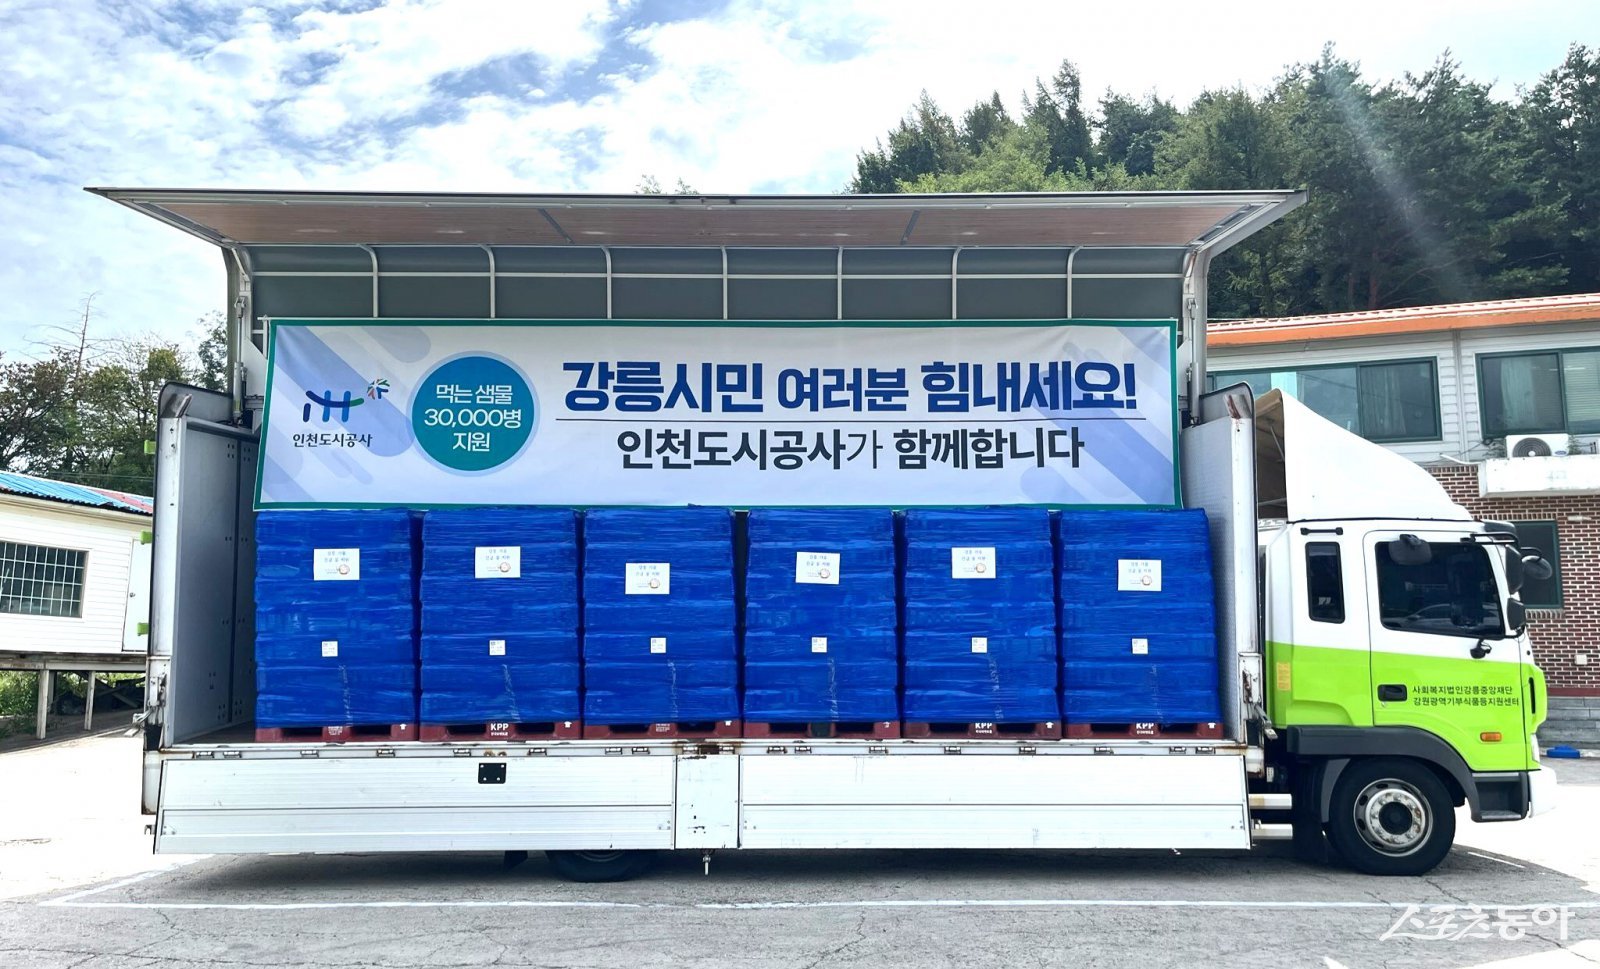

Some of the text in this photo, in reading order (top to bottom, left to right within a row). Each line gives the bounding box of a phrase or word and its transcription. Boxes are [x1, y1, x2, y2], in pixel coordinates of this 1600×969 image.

[436, 384, 513, 404] 먹는 샘물
[562, 360, 1137, 413] 강릉시민 여러분 힘내세요!
[423, 408, 522, 429] 30,000병
[292, 432, 373, 448] 인천도시공사
[452, 431, 491, 452] 지원
[617, 426, 1085, 470] 인천도시공사가 함께합니다
[490, 723, 509, 731] KPP
